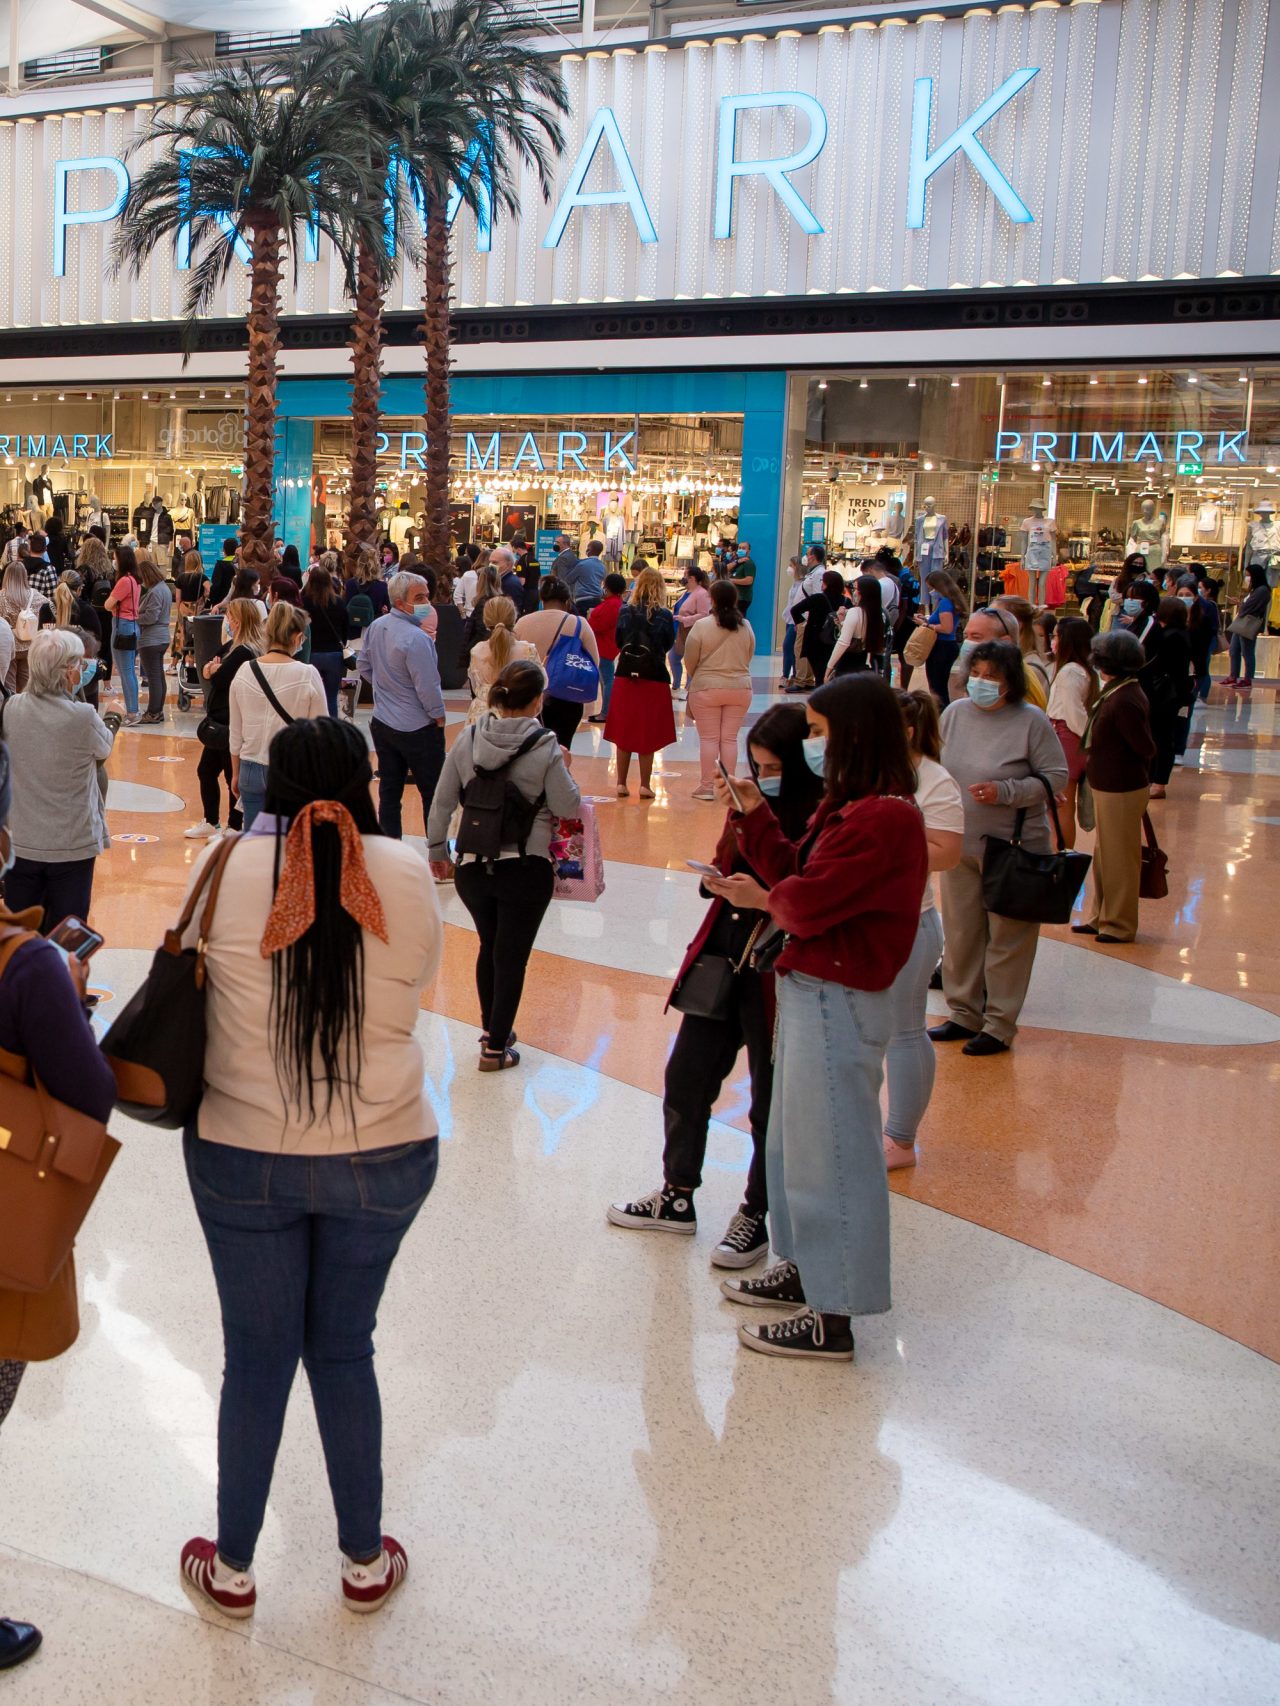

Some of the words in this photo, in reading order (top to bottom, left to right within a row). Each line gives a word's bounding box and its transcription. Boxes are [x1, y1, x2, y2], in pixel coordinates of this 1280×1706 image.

[375, 431, 638, 472] PRMARK
[994, 430, 1249, 463] PRIMARK
[848, 498, 886, 508] TREND
